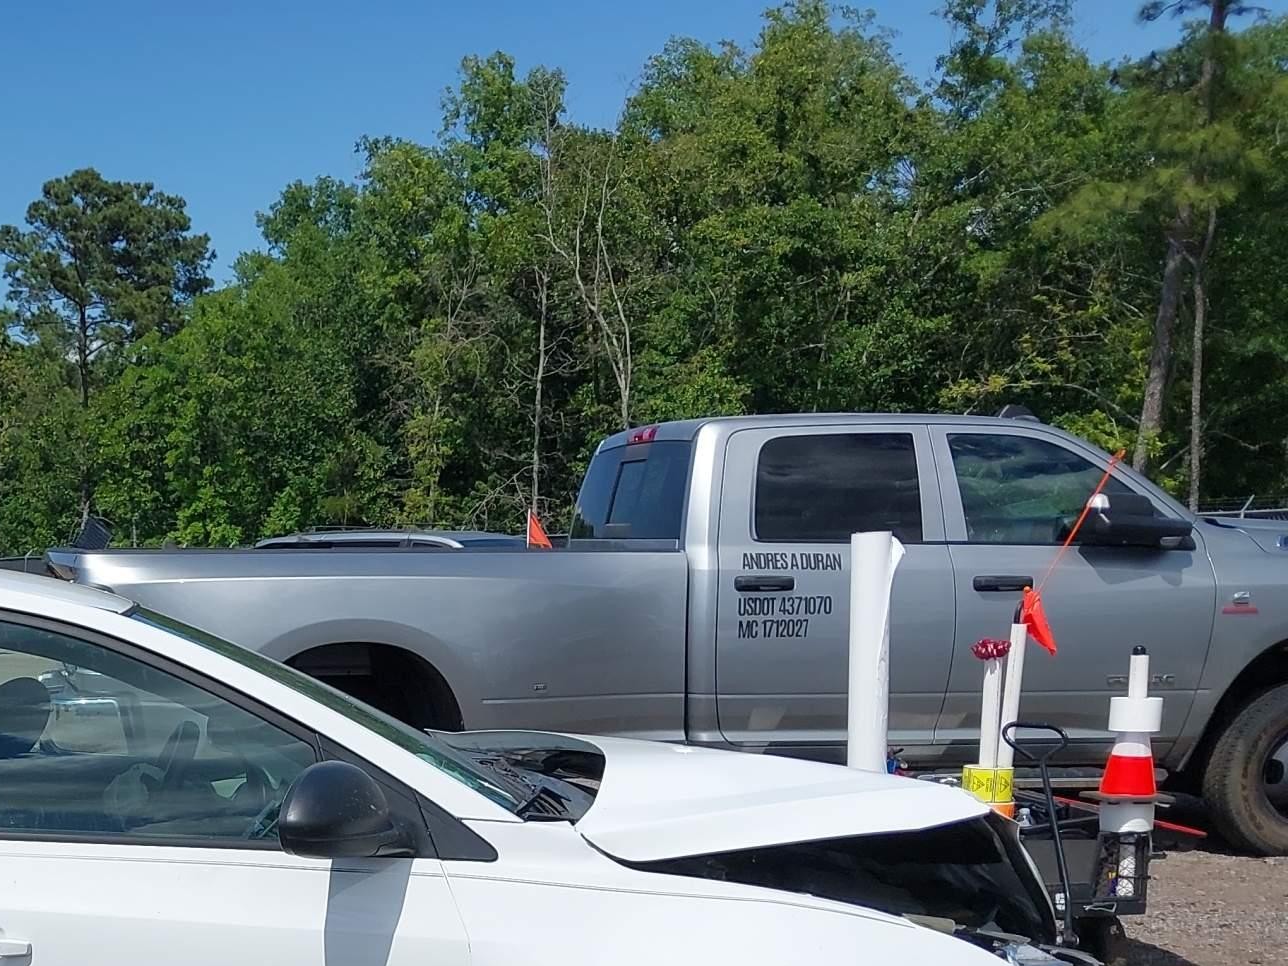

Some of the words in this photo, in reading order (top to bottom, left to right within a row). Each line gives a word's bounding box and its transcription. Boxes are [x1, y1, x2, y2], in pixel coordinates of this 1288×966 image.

[742, 552, 788, 570] ANDRES
[790, 553, 799, 570] A
[801, 553, 842, 571] DURAN
[738, 597, 777, 617] USDOT
[778, 596, 832, 615] 4371070
[738, 620, 758, 639] MC
[762, 619, 809, 638] 1712027
